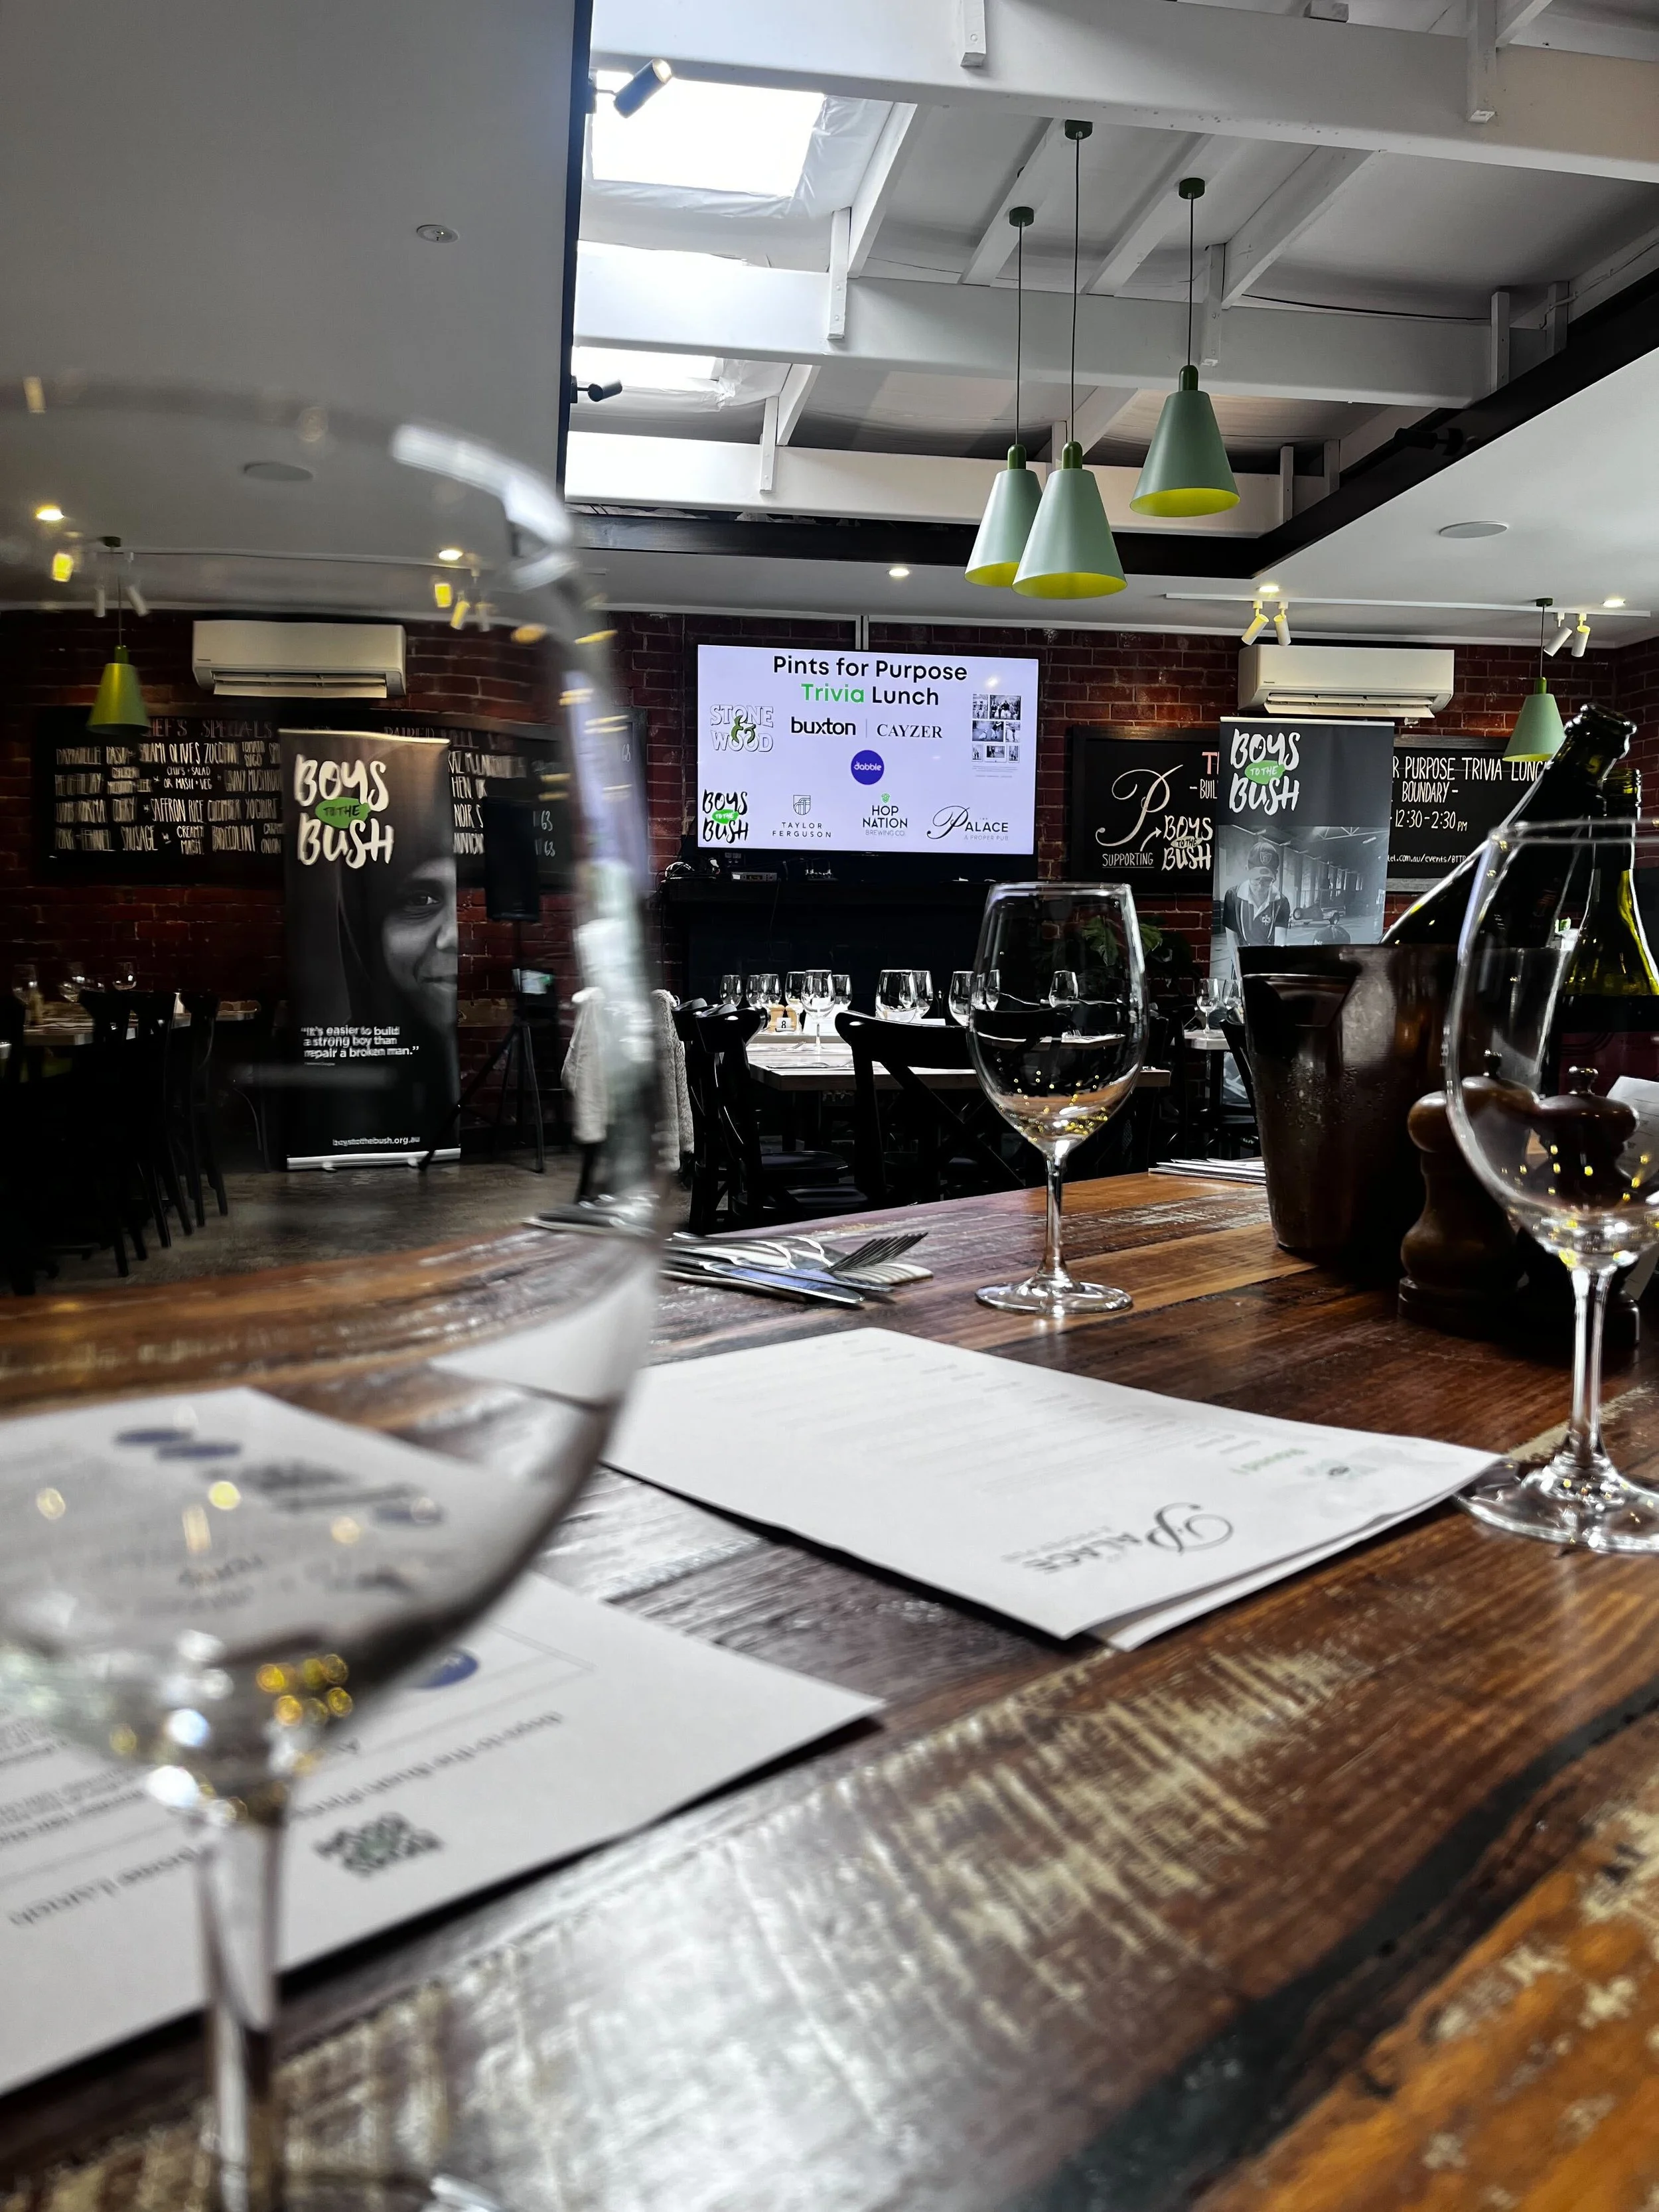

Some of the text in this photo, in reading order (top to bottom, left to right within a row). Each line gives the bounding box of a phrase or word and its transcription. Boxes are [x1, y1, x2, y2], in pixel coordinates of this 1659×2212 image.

[774, 655, 968, 683] Pints for Purpose
[801, 683, 939, 705] Trivia Lunch
[710, 704, 773, 728] STONE
[791, 716, 856, 735] buxton
[711, 729, 773, 752] WOOD
[877, 723, 943, 739] CAYZER
[169, 742, 200, 765] OLIVES
[1230, 728, 1301, 771] BOYS
[191, 766, 211, 776] SALAD
[853, 761, 881, 771] dabble
[1250, 765, 1279, 776] TO THE
[1405, 757, 1456, 780] PURPOSE
[1461, 757, 1502, 781] TRIVIA
[1511, 761, 1546, 782] LUNC
[199, 778, 212, 790] VEG
[294, 753, 390, 812] BOYS
[1200, 778, 1220, 799] BUIL
[1402, 781, 1450, 803] BOUNDARY
[703, 788, 748, 816] BOYS
[1229, 773, 1300, 816] BUSH
[150, 798, 186, 822] SAFFRON
[188, 798, 206, 824] RICE
[323, 805, 360, 818] TO THE
[454, 804, 475, 829] NOIR
[871, 805, 899, 816] HOP
[703, 817, 749, 844] BUSH
[863, 817, 908, 828] NATION
[1163, 815, 1214, 841] BOYS
[1457, 822, 1468, 832] PM
[297, 812, 395, 869] BUSH
[1185, 838, 1196, 847] THE
[1102, 852, 1154, 867] SUPPORTING
[1161, 843, 1212, 871] BUSH
[303, 1035, 397, 1048] a strong boy than
[326, 1025, 358, 1036] easier
[360, 1026, 372, 1035] to
[374, 1026, 400, 1035] build
[304, 1048, 337, 1060] repair
[349, 1047, 386, 1057] broken
